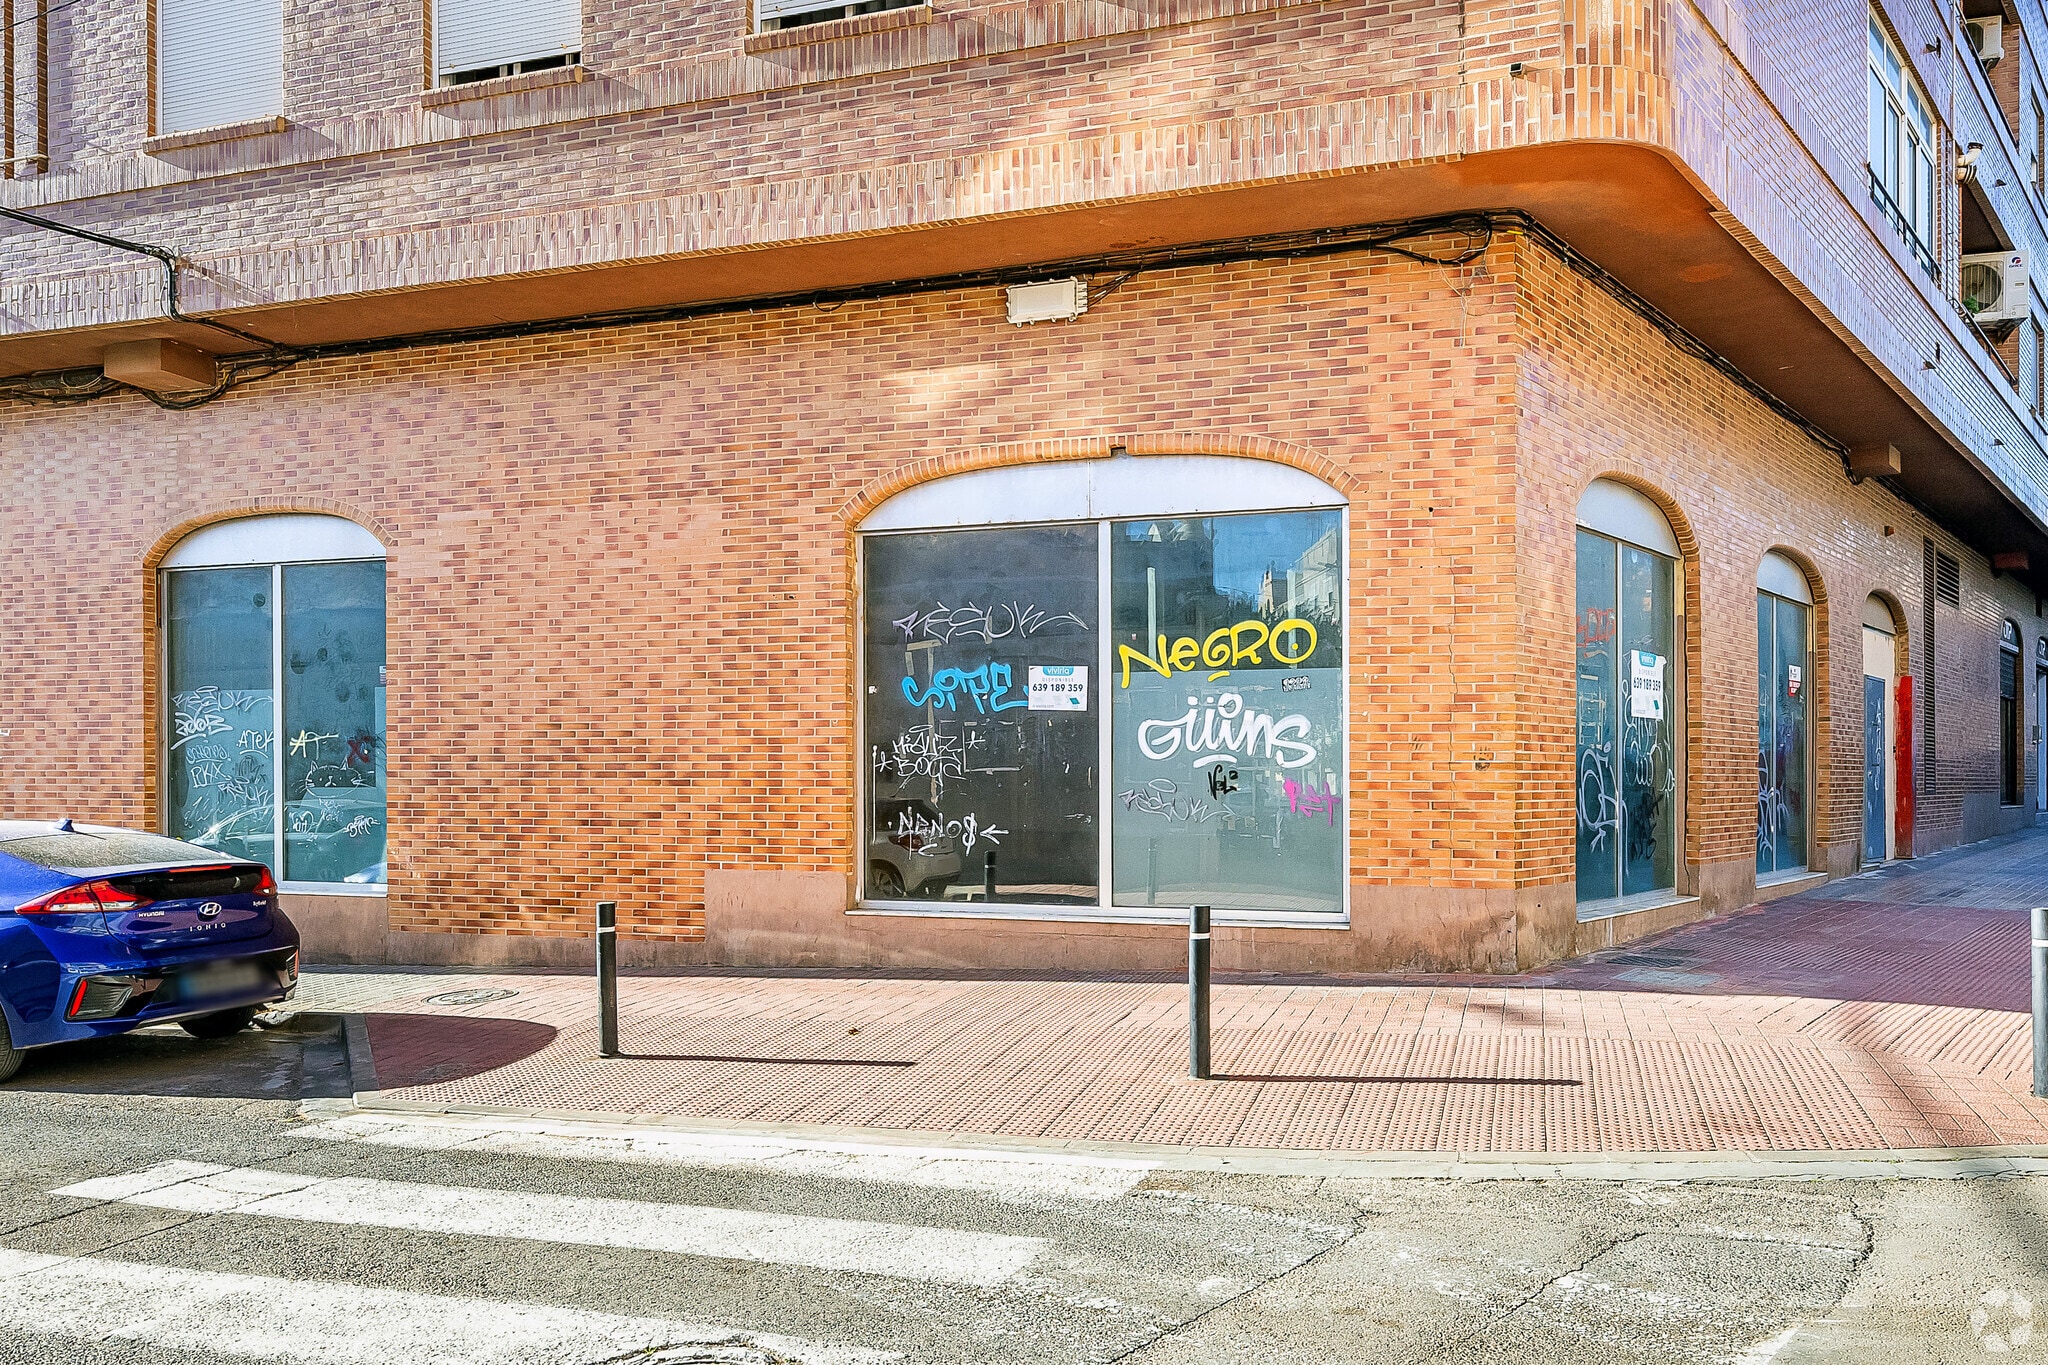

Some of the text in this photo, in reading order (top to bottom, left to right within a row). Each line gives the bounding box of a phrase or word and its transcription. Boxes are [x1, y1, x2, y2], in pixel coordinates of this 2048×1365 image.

[1032, 683, 1084, 692] 639 189 359
[1633, 677, 1661, 692] 639 189 359
